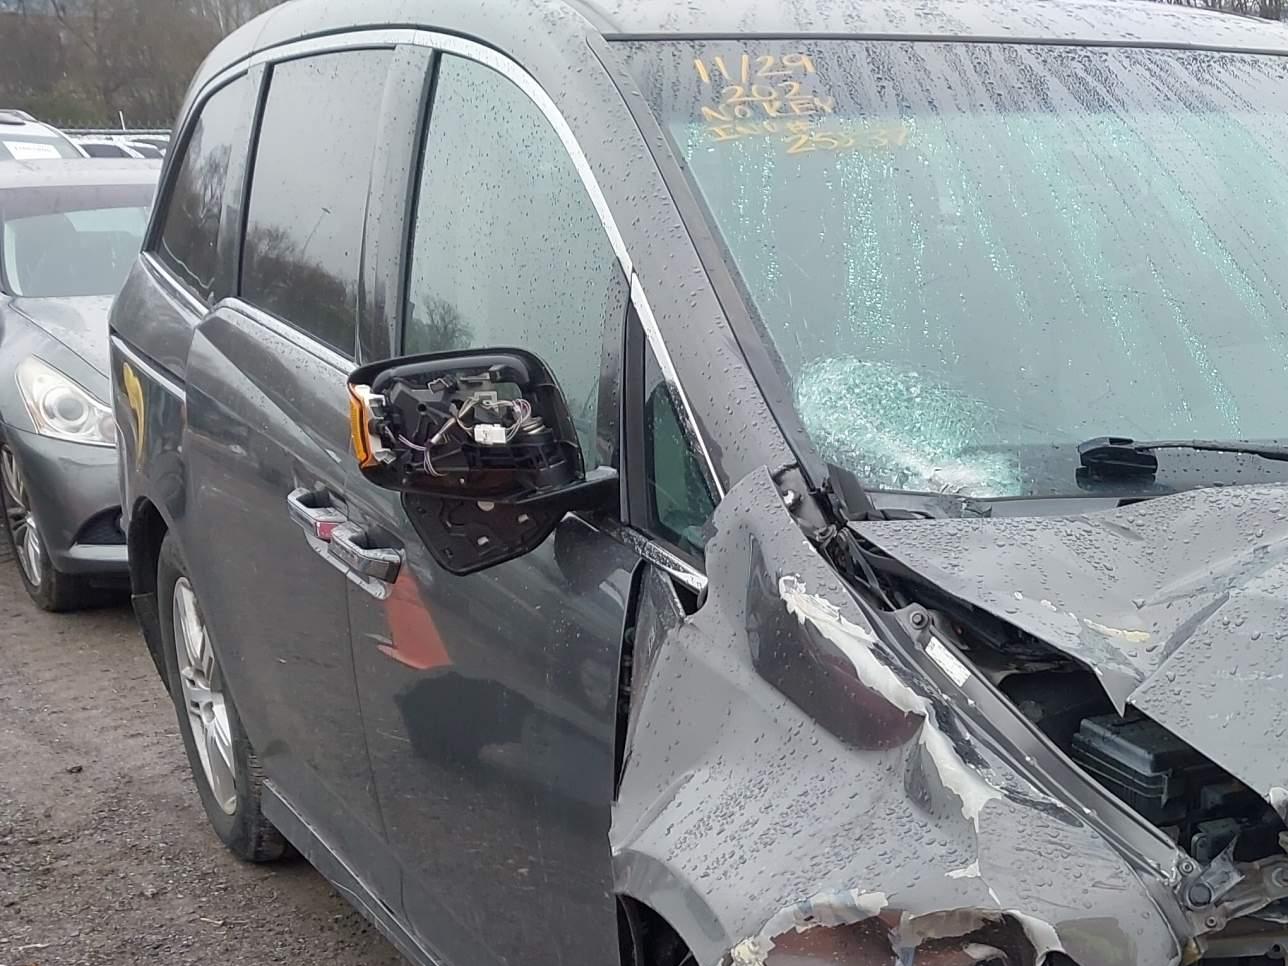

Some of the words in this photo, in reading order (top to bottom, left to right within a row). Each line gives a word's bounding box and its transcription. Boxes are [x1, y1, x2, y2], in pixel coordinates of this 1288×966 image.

[694, 53, 816, 84] 11/29
[720, 81, 813, 104] 202
[701, 103, 751, 121] NO
